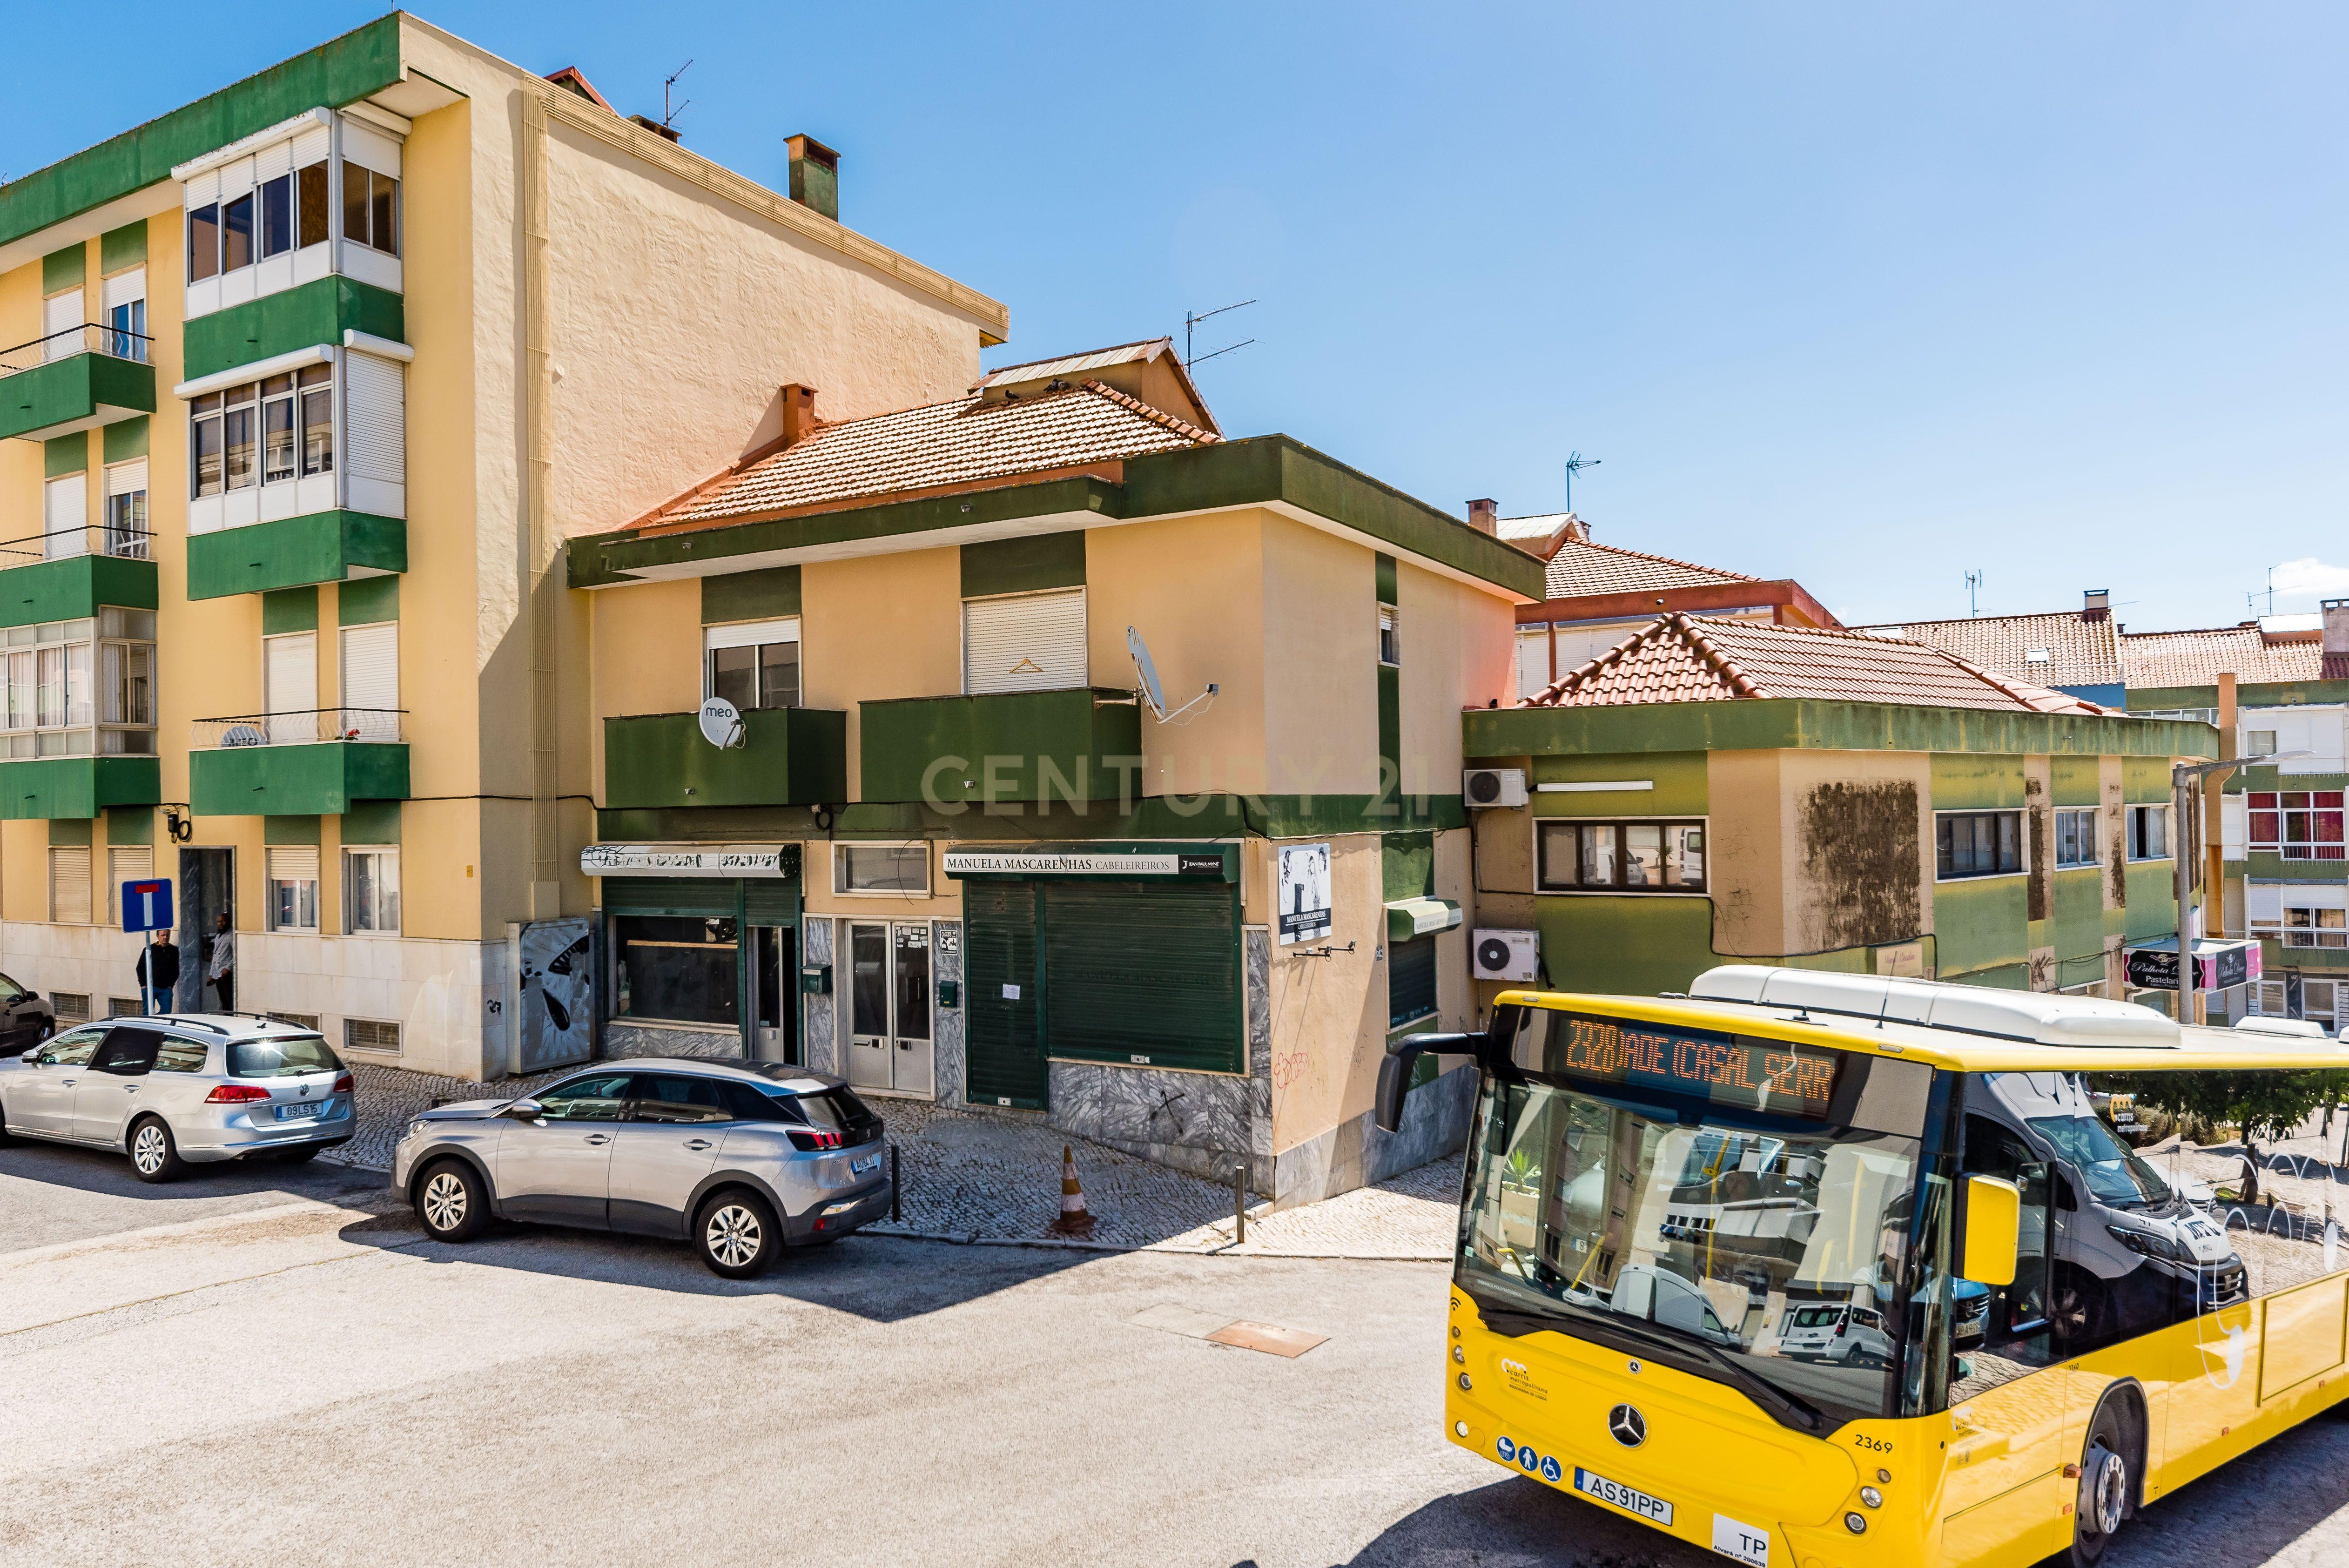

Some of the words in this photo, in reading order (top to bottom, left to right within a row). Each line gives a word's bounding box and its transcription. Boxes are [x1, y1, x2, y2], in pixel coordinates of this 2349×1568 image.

[706, 707, 732, 718] meo
[947, 858, 1002, 868] MANUELA
[1004, 859, 1092, 870] MASCARENHAS
[1096, 861, 1170, 870] CABELEIREIROS
[2146, 976, 2179, 984] Pastelari
[1762, 1053, 1835, 1101] SERR
[1510, 1370, 1529, 1381] carris
[1509, 1376, 1548, 1394] metropolitana
[1855, 1434, 1893, 1454] 2369
[1590, 1477, 1664, 1517] AS91PP
[1739, 1533, 1766, 1555] TP
